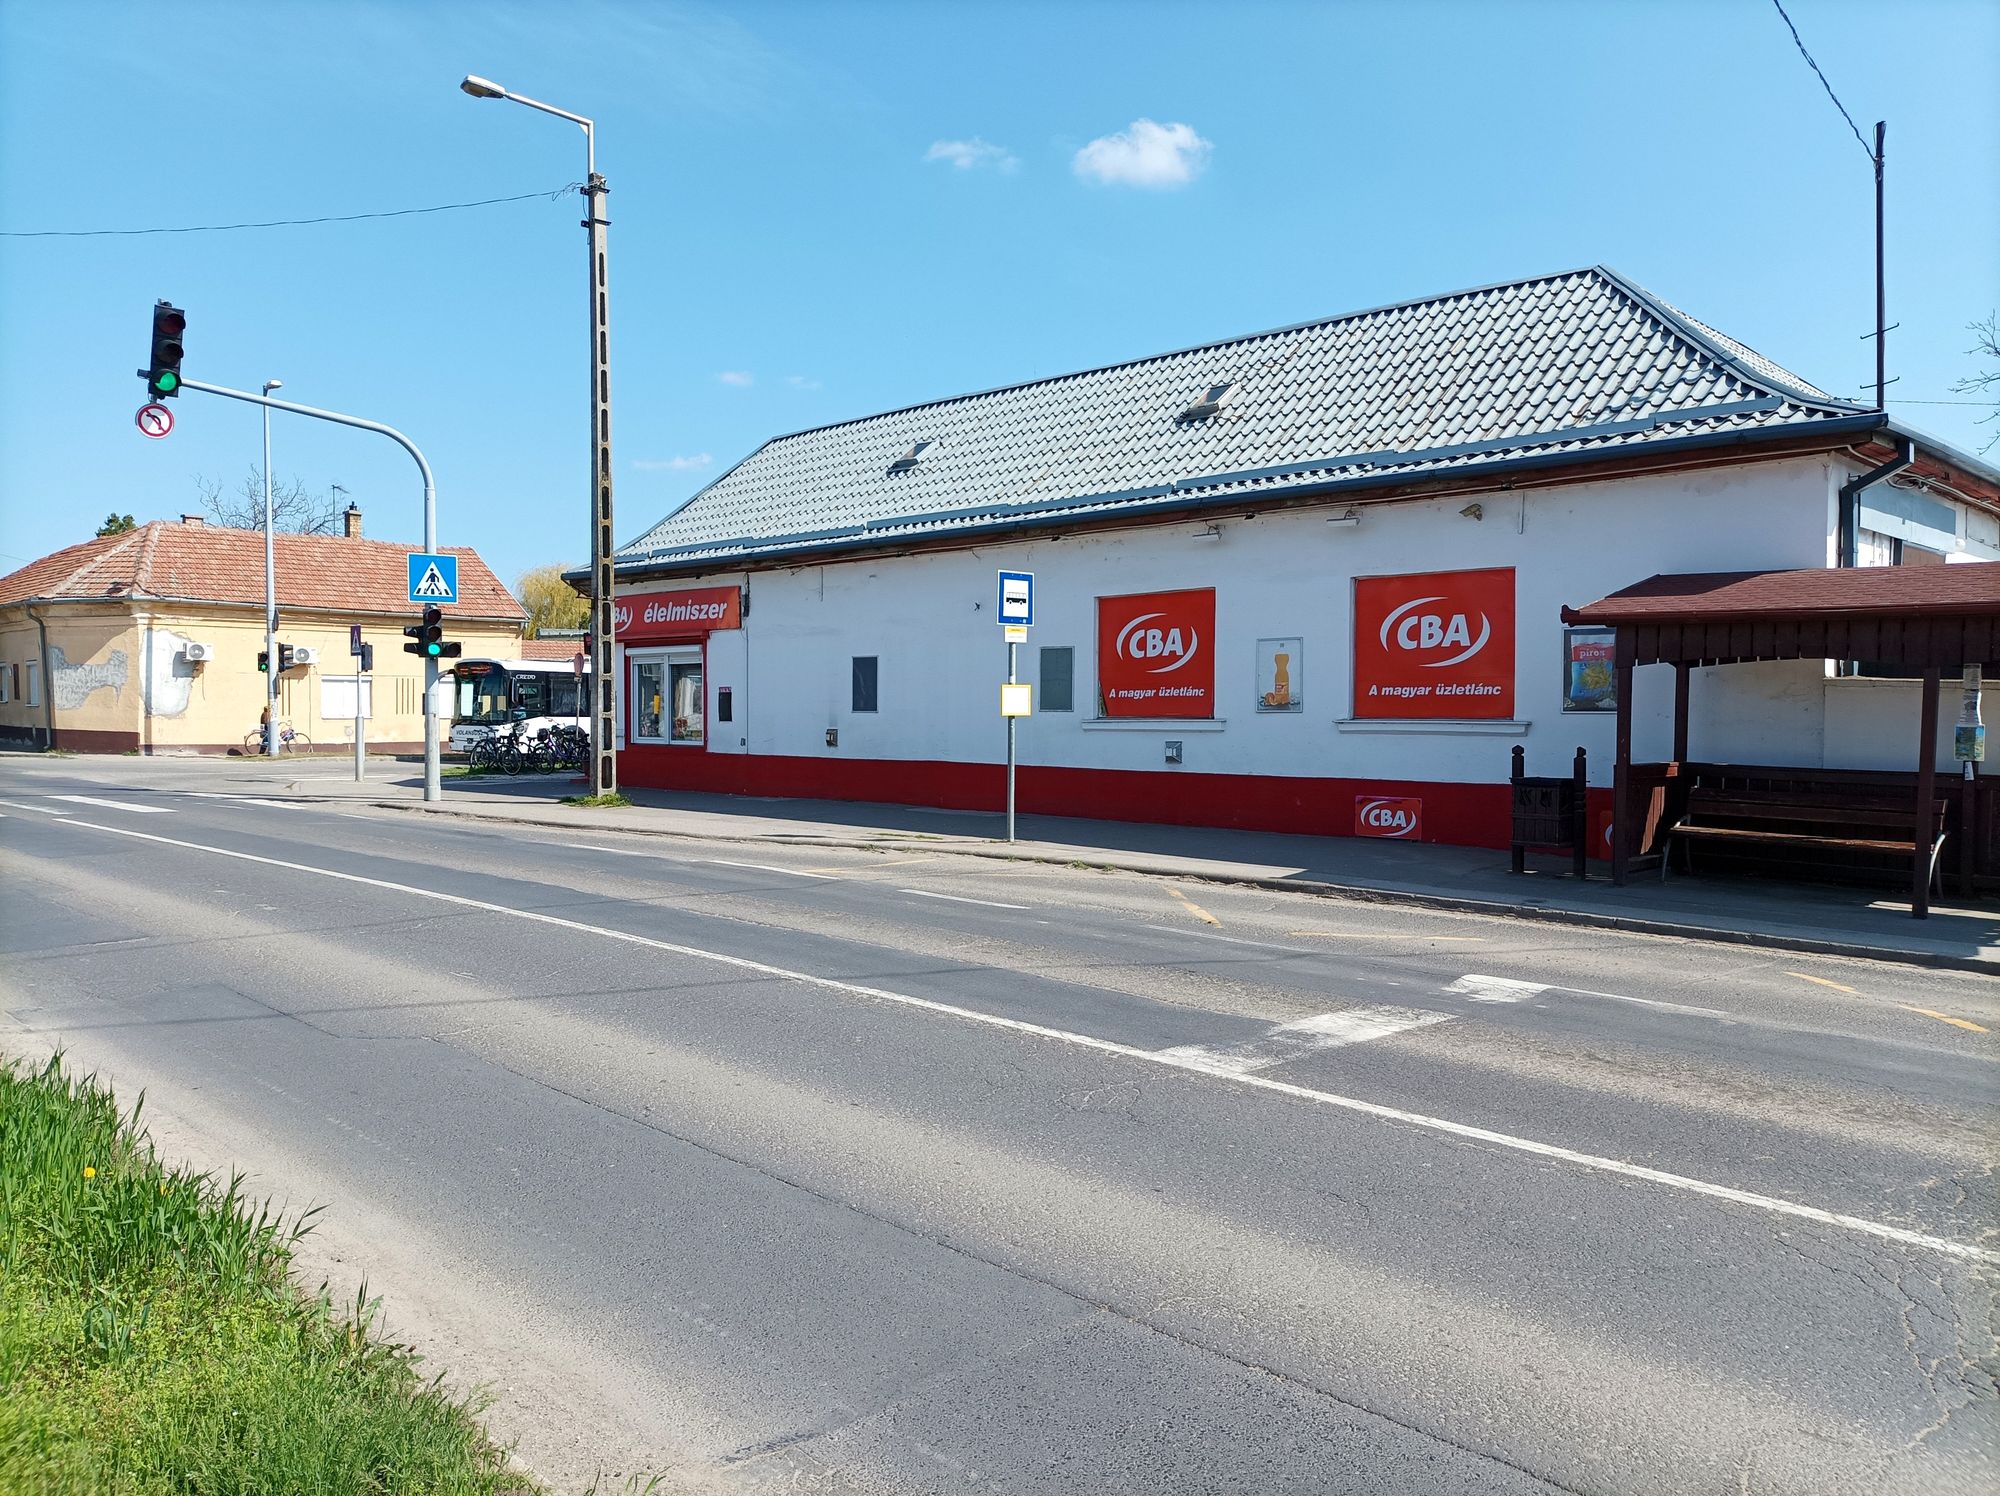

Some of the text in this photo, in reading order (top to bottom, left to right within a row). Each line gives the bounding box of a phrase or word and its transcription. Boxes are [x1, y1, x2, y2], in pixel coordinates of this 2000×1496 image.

[615, 599, 728, 624] BA élelmiszer
[1397, 613, 1471, 650] CBA
[1129, 627, 1184, 659] CBA
[1109, 686, 1205, 700] A magyar üzletlánc
[1368, 683, 1502, 698] A magyar üzletlánc
[1369, 808, 1407, 827] CBA
